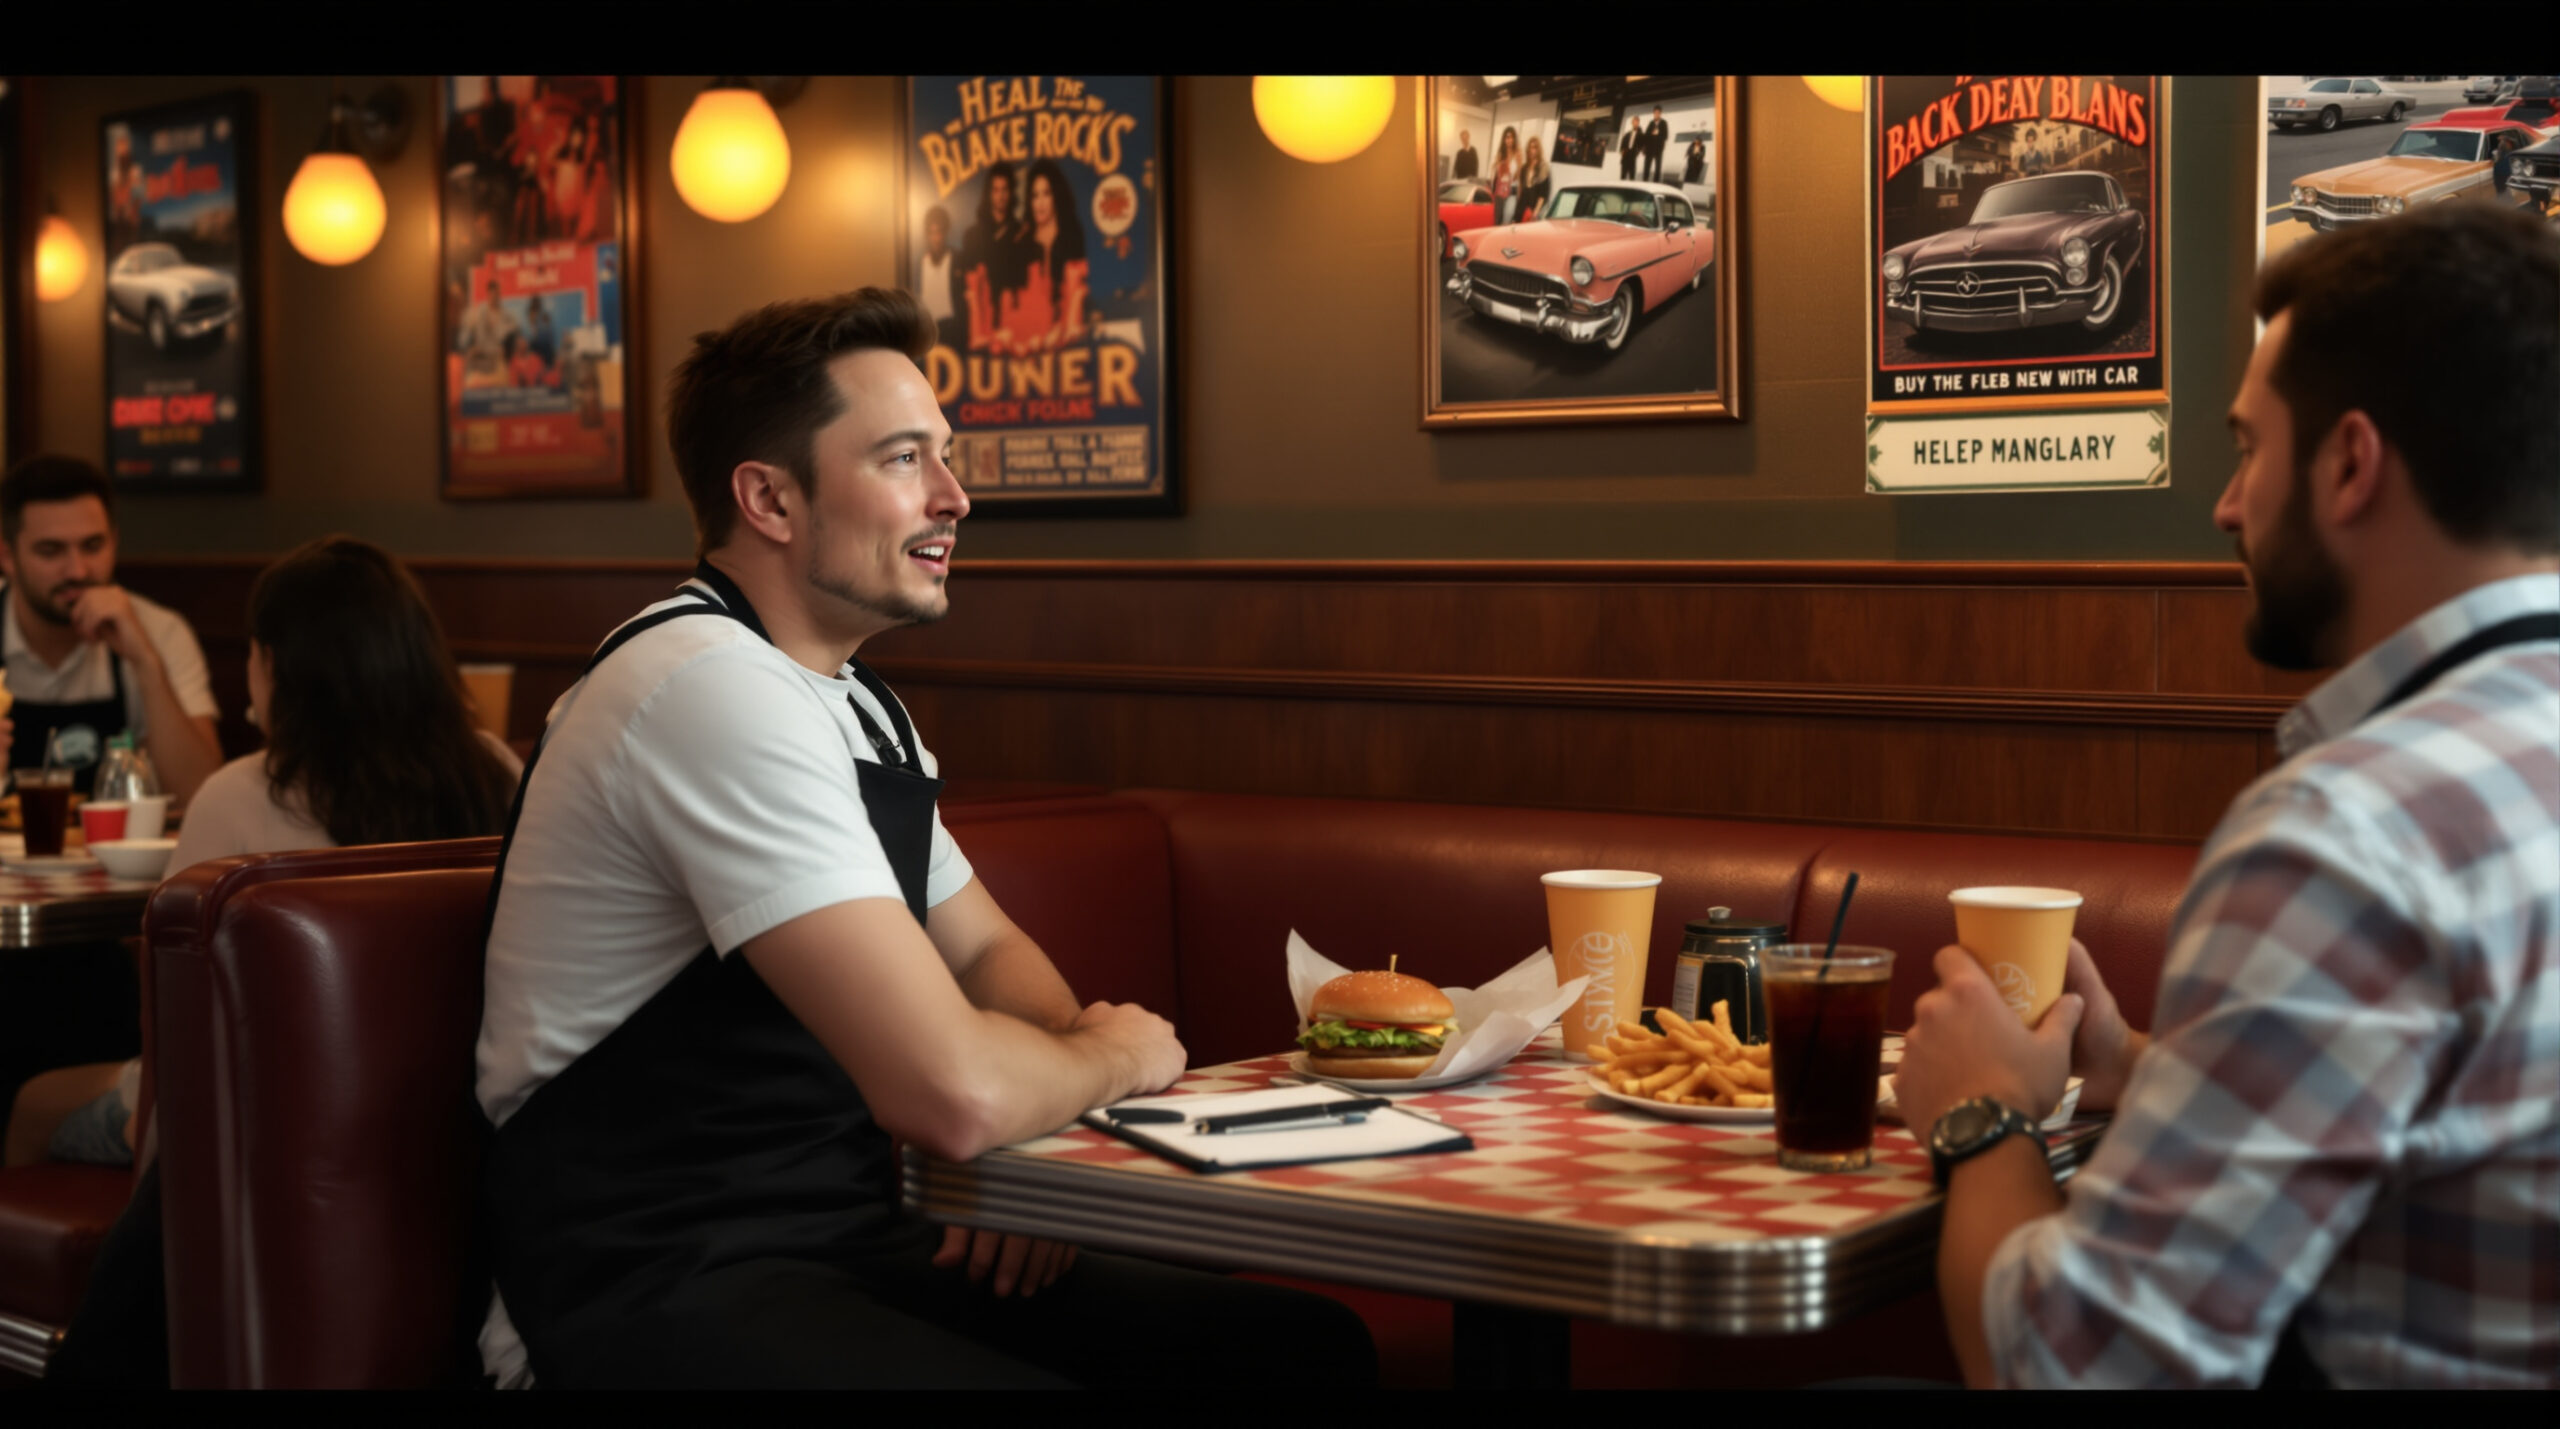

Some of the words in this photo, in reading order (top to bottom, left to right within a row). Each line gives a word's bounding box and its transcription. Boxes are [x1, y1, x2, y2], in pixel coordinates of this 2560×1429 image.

[958, 76, 1046, 126] HEAL
[1887, 91, 1963, 180] BACK
[1969, 76, 2044, 130] DEAY
[2049, 76, 2147, 145] BLANS
[920, 116, 1028, 197] BLAKE
[1033, 110, 1136, 176] ROCKS
[1894, 374, 1927, 393] BUY
[1933, 373, 1964, 392] THE
[1970, 371, 2010, 390] FLEB
[2016, 370, 2053, 388] NEW
[2058, 368, 2098, 386] WITH
[2104, 366, 2139, 384] CAR
[1913, 440, 1984, 465] HELEP
[1991, 435, 2116, 463] MANGLARY
